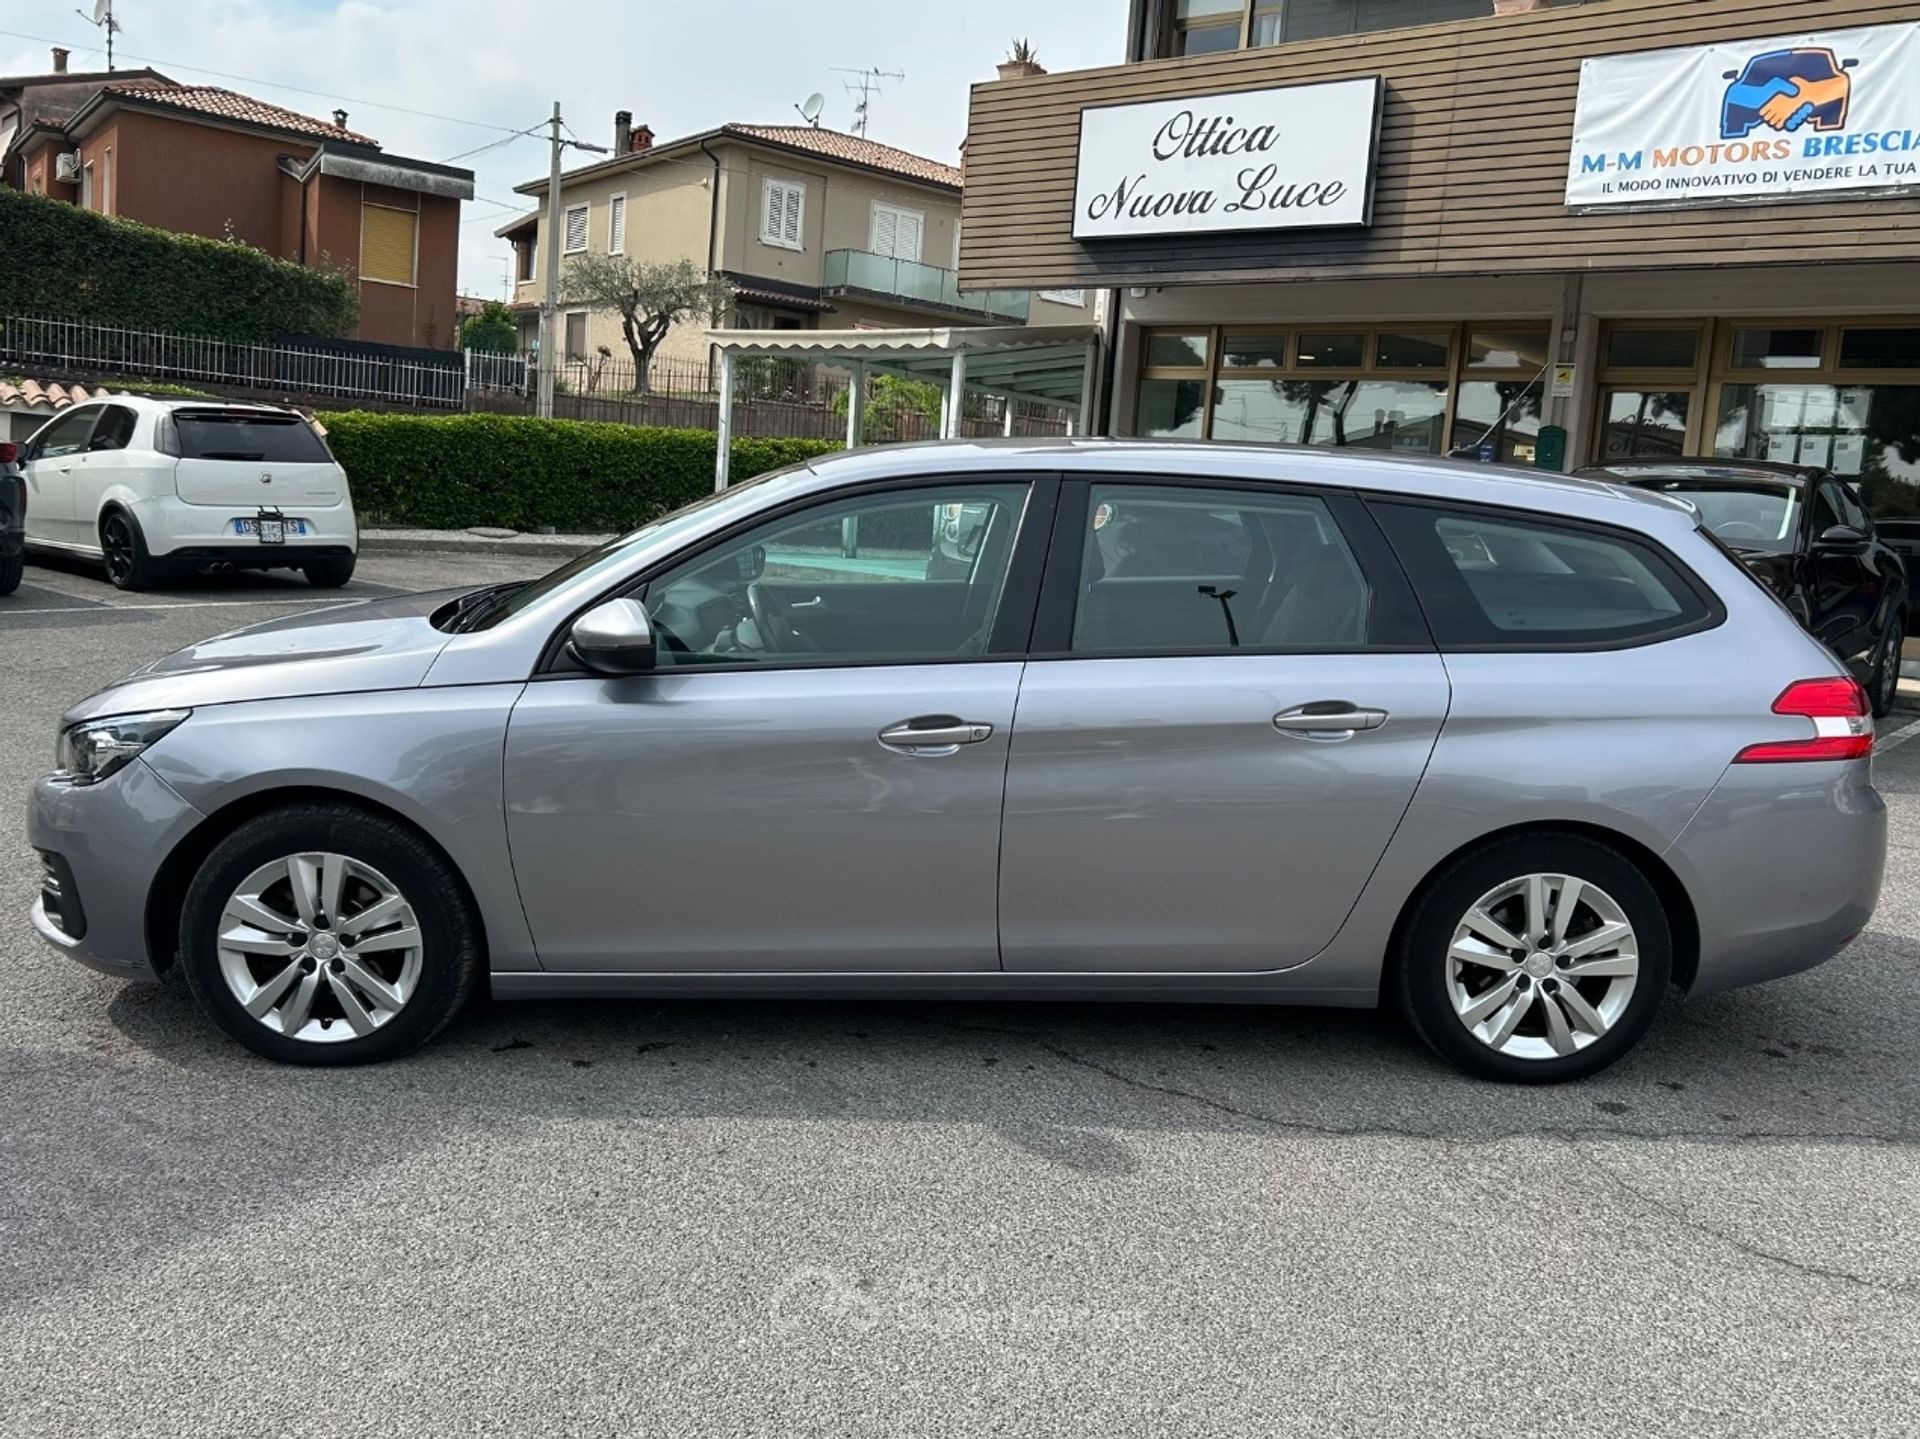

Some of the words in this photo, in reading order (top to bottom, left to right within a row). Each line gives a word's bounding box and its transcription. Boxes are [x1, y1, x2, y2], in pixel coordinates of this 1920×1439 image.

[1152, 110, 1280, 161] Ottica
[1581, 150, 1642, 173] M-M
[1652, 139, 1792, 168] MOTORS
[1087, 174, 1218, 220] Nuova
[1223, 163, 1347, 213] Luce
[1602, 181, 1614, 193] IL
[1617, 178, 1661, 192] MODO
[1665, 172, 1757, 189] INNOVATIVO
[1762, 171, 1778, 183] DI
[1783, 166, 1853, 182] VENDERE
[1858, 163, 1878, 176] LA
[1884, 161, 1917, 174] TUA
